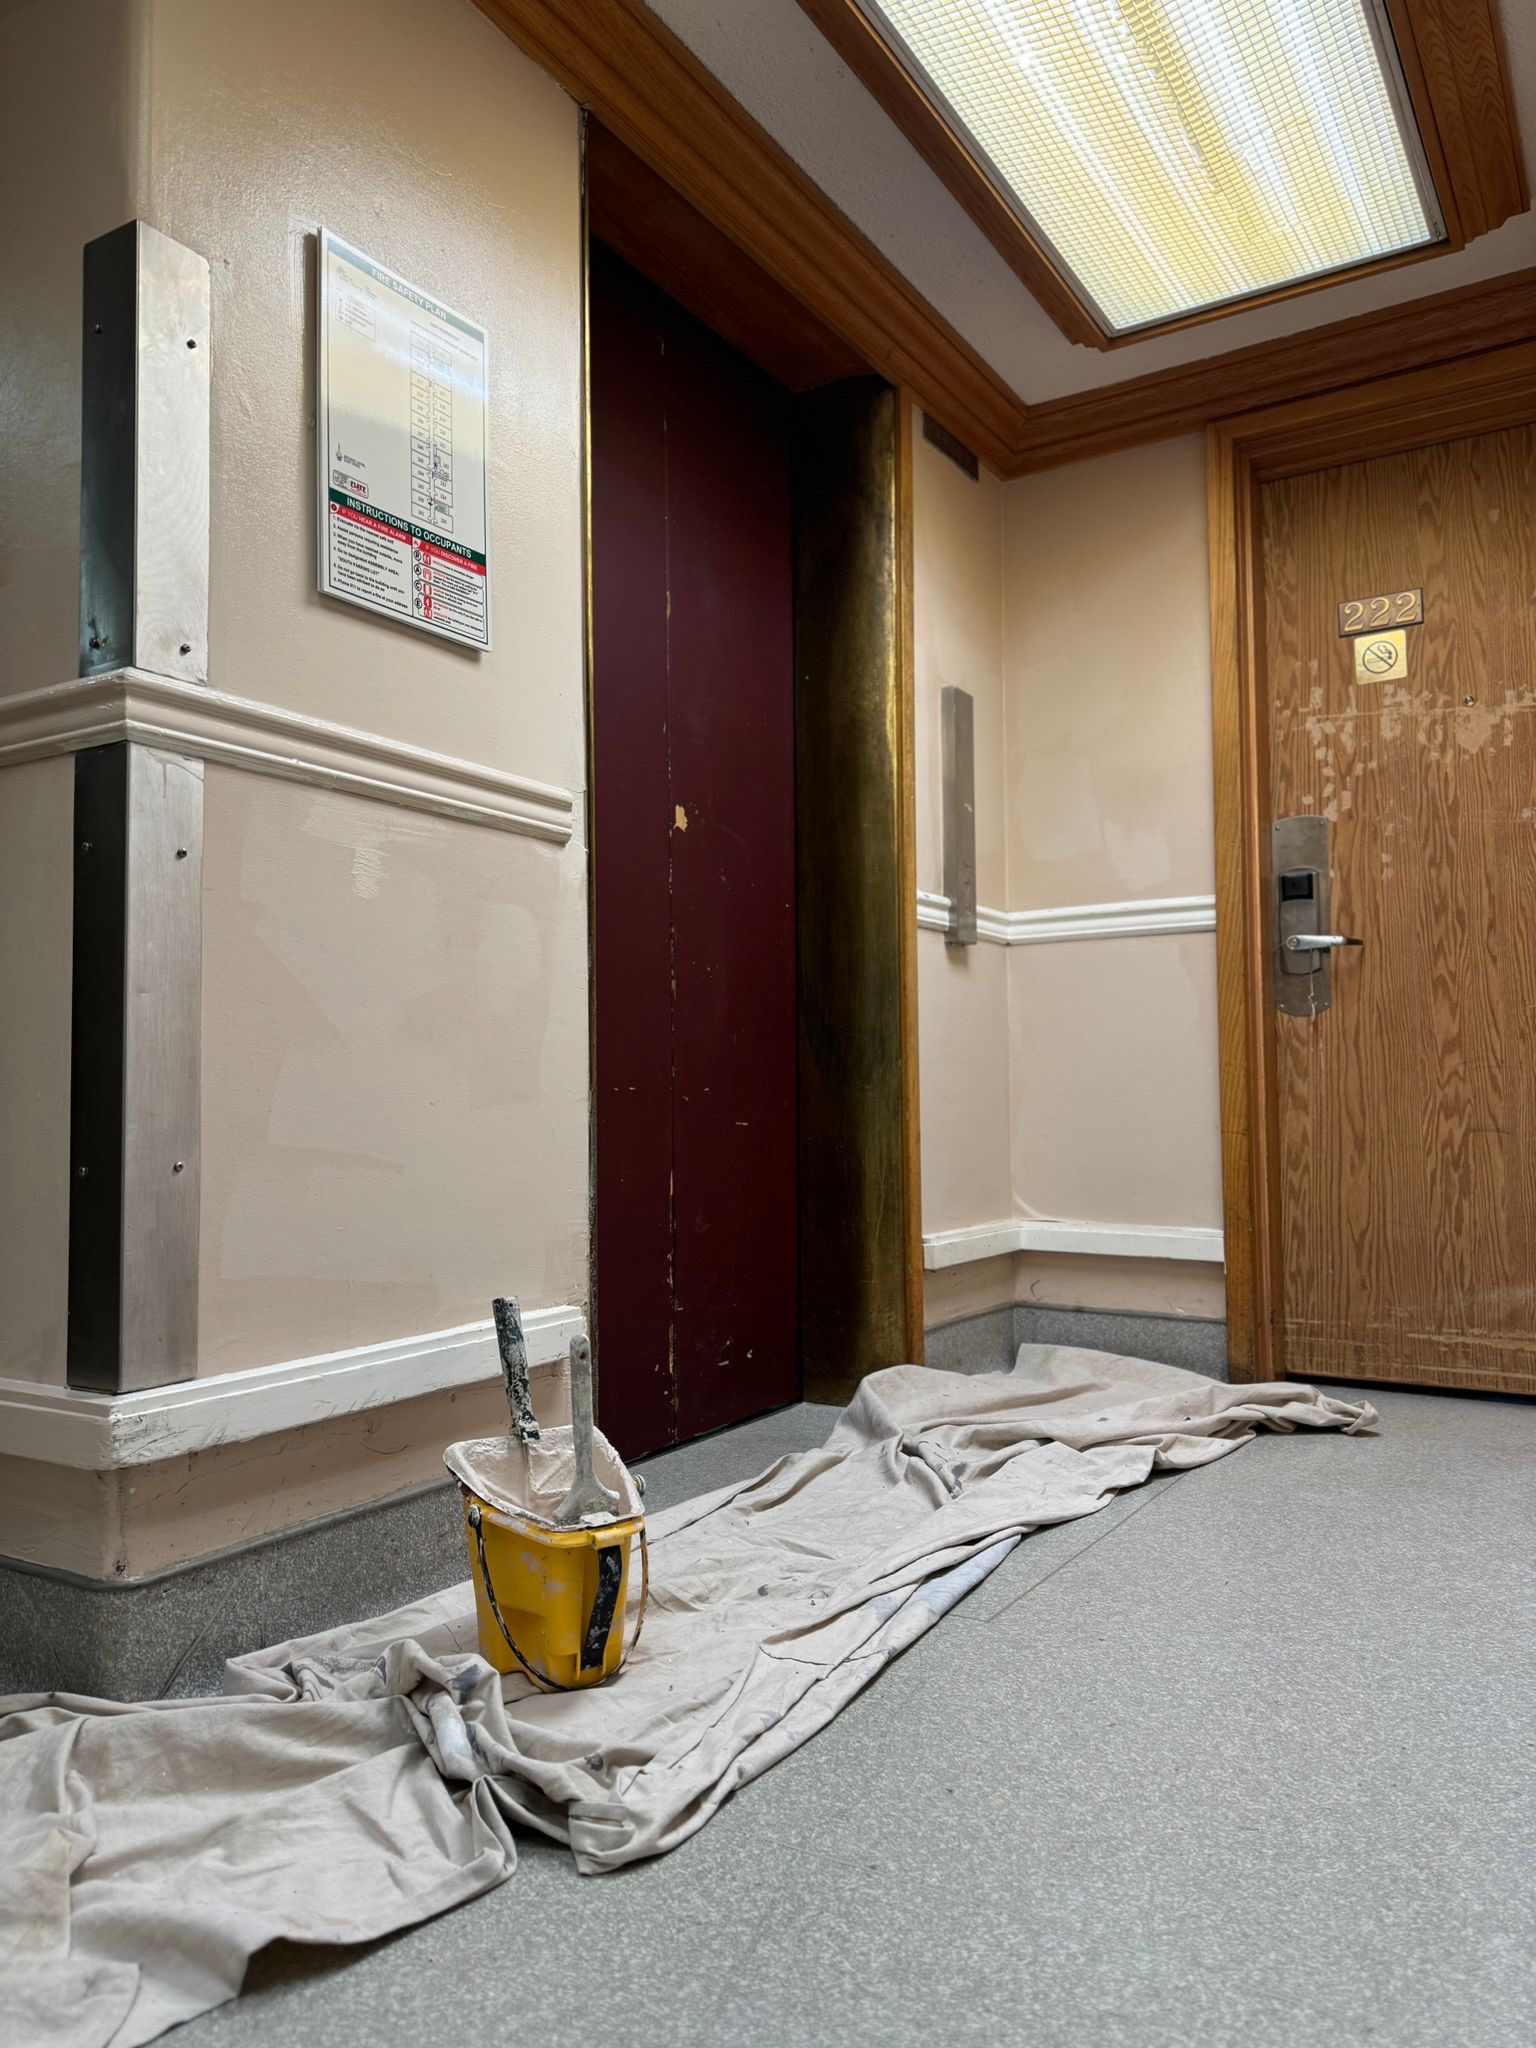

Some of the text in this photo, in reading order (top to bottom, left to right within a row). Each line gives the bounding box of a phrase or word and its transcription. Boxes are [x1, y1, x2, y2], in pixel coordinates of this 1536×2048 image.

[371, 268, 390, 287] FIRE
[392, 281, 424, 306] SAFETY
[425, 301, 447, 320] PLAN
[347, 497, 408, 531] INSTRUCTIONS
[411, 525, 422, 536] TO
[423, 531, 472, 558] OCCUPANTS
[348, 510, 358, 520] YOU
[359, 515, 372, 525] HEAR
[377, 523, 388, 532] FIRE
[389, 528, 406, 540] ALARM
[441, 551, 464, 564] DISCOVER
[468, 562, 478, 571] FIRE
[1344, 592, 1417, 632] 222
